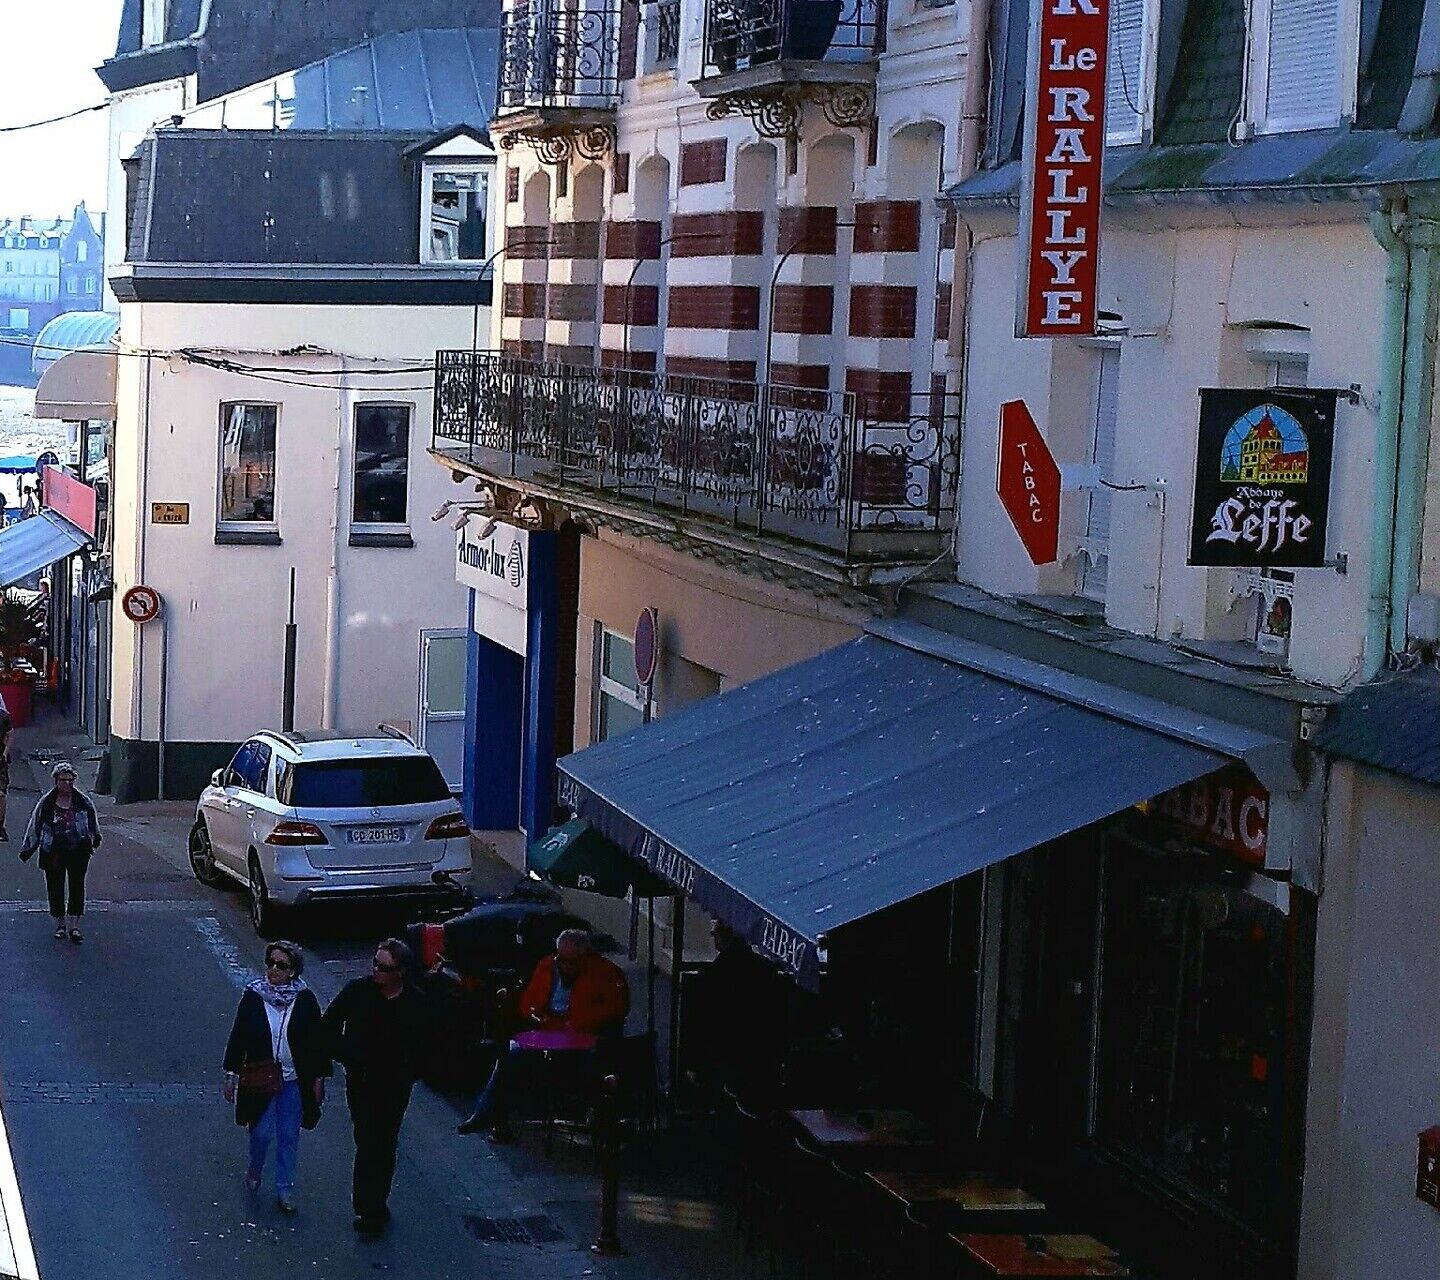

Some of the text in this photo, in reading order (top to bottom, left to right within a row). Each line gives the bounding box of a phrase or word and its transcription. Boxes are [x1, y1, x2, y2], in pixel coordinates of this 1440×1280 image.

[1048, 38, 1098, 71] Le
[1040, 86, 1095, 325] RALLYE
[1017, 442, 1043, 523] TABAC
[1236, 486, 1284, 500] Abbaye
[1205, 497, 1312, 553] Leffe
